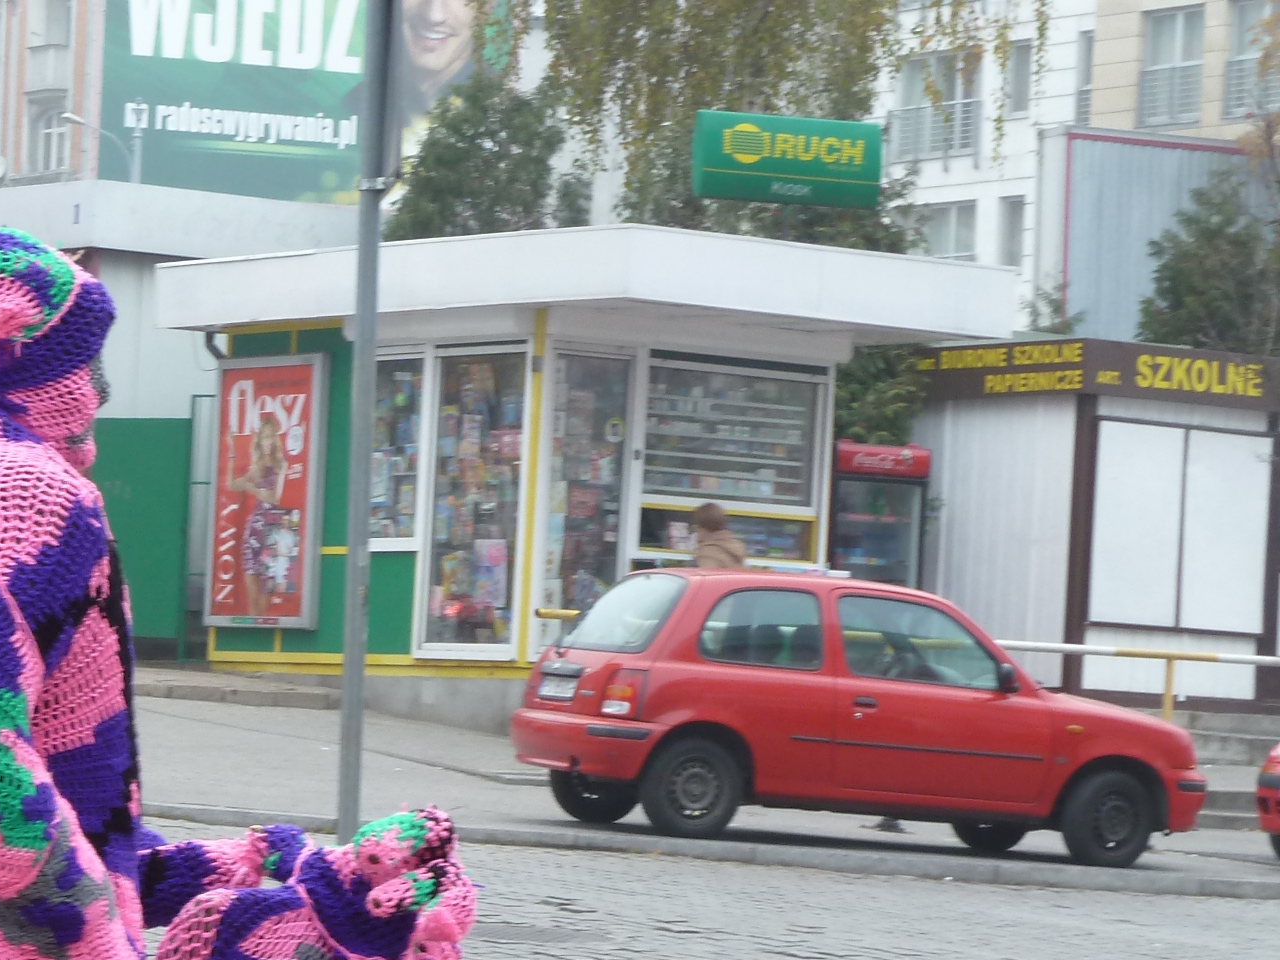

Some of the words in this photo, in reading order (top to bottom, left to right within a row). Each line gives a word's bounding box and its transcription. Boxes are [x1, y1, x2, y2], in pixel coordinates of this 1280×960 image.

[773, 133, 865, 165] RUCH
[1013, 342, 1084, 365] SZKOLNE
[984, 369, 1084, 394] PAPIERNICZE
[1135, 354, 1264, 397] SZKOLNE
